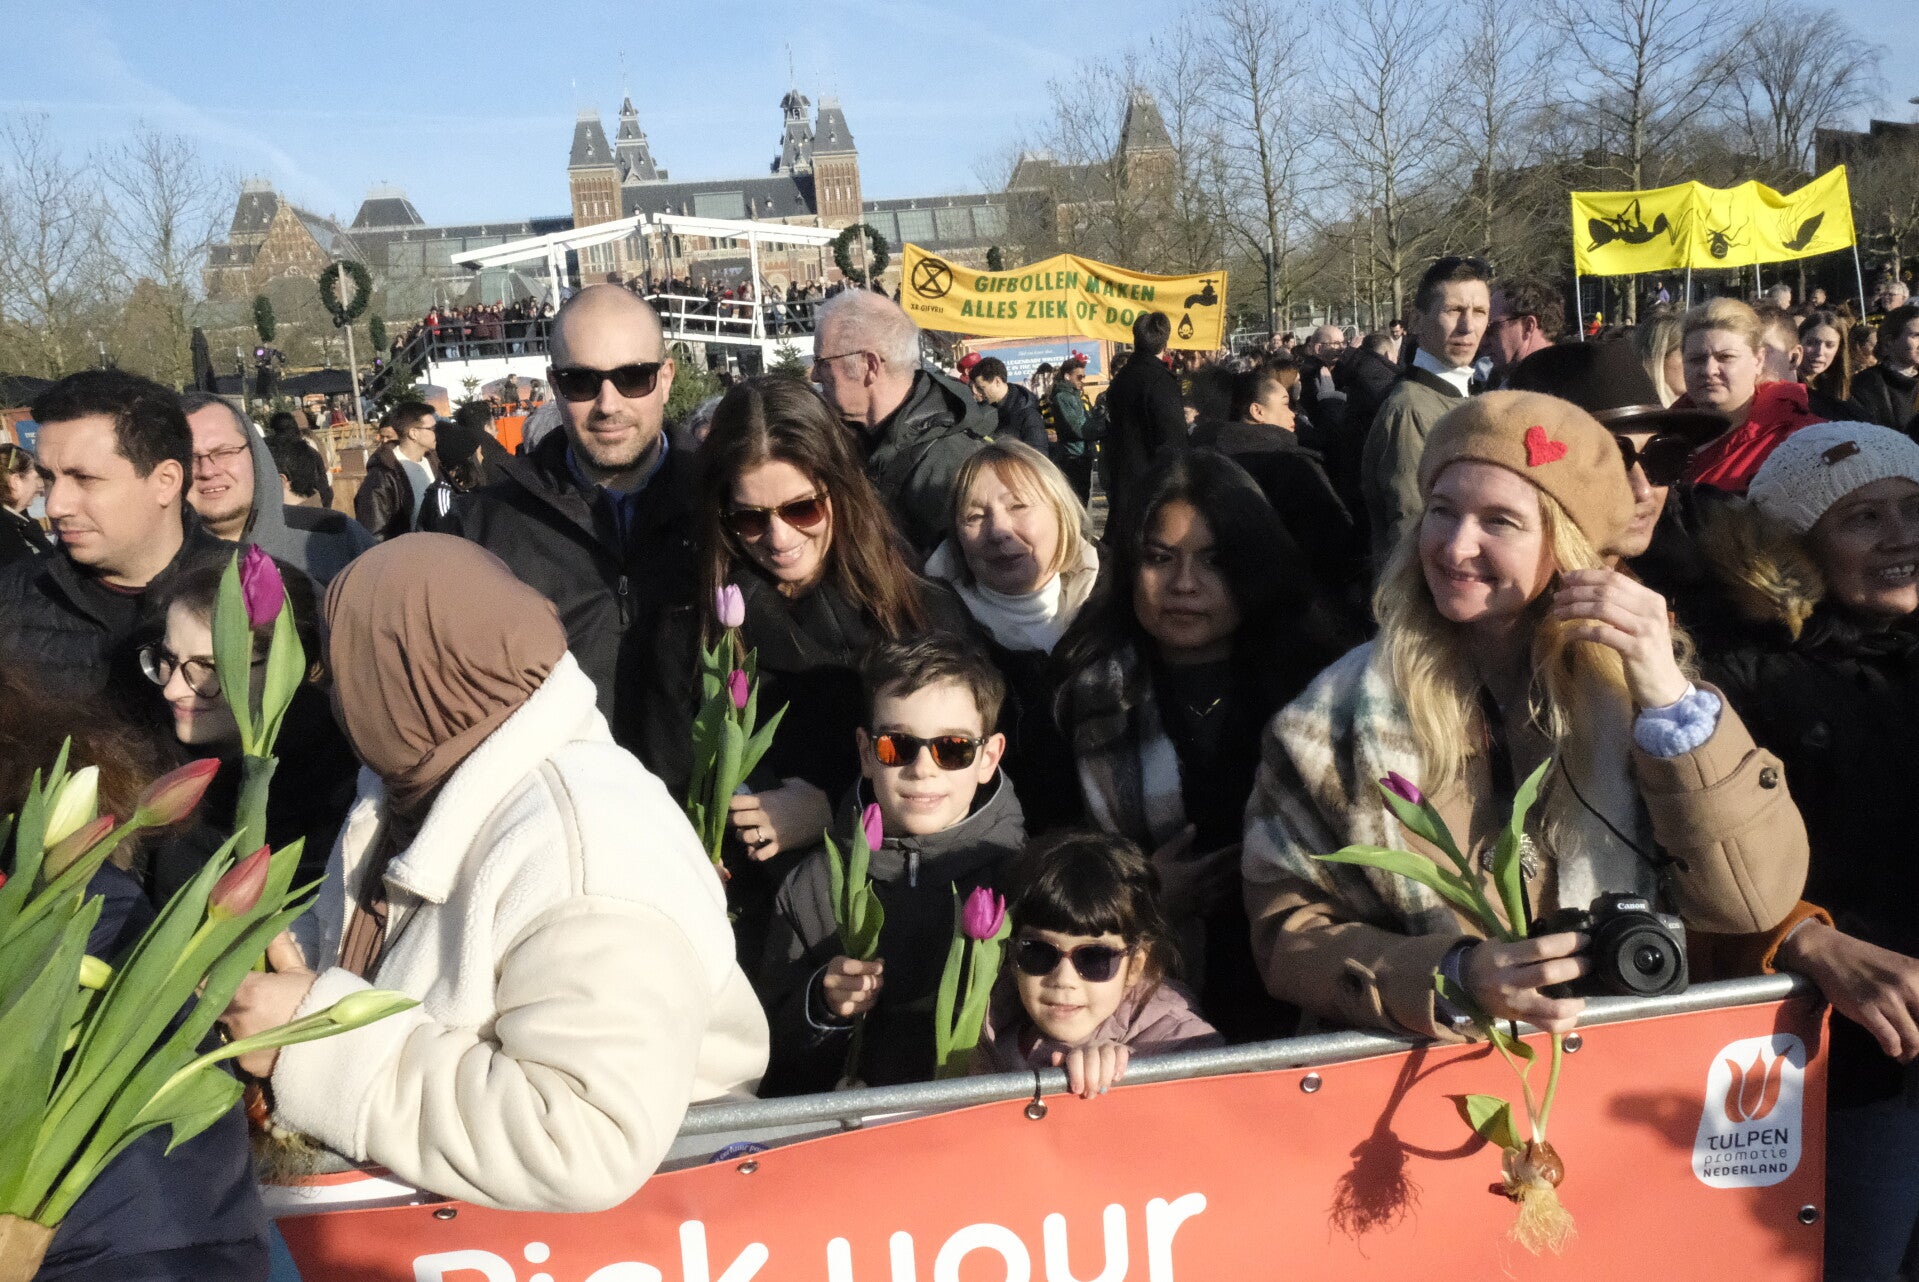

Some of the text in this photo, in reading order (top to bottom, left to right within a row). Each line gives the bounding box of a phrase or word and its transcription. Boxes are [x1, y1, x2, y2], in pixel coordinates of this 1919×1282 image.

[974, 271, 1155, 302] GIFBOLLEN MAKEN
[961, 299, 1149, 327] ALLES ZIEK OF DO
[1617, 902, 1646, 910] Canon
[1707, 1128, 1788, 1150] TULPEN
[1704, 1147, 1788, 1167] promotie
[1703, 1163, 1788, 1178] NEDERLAND
